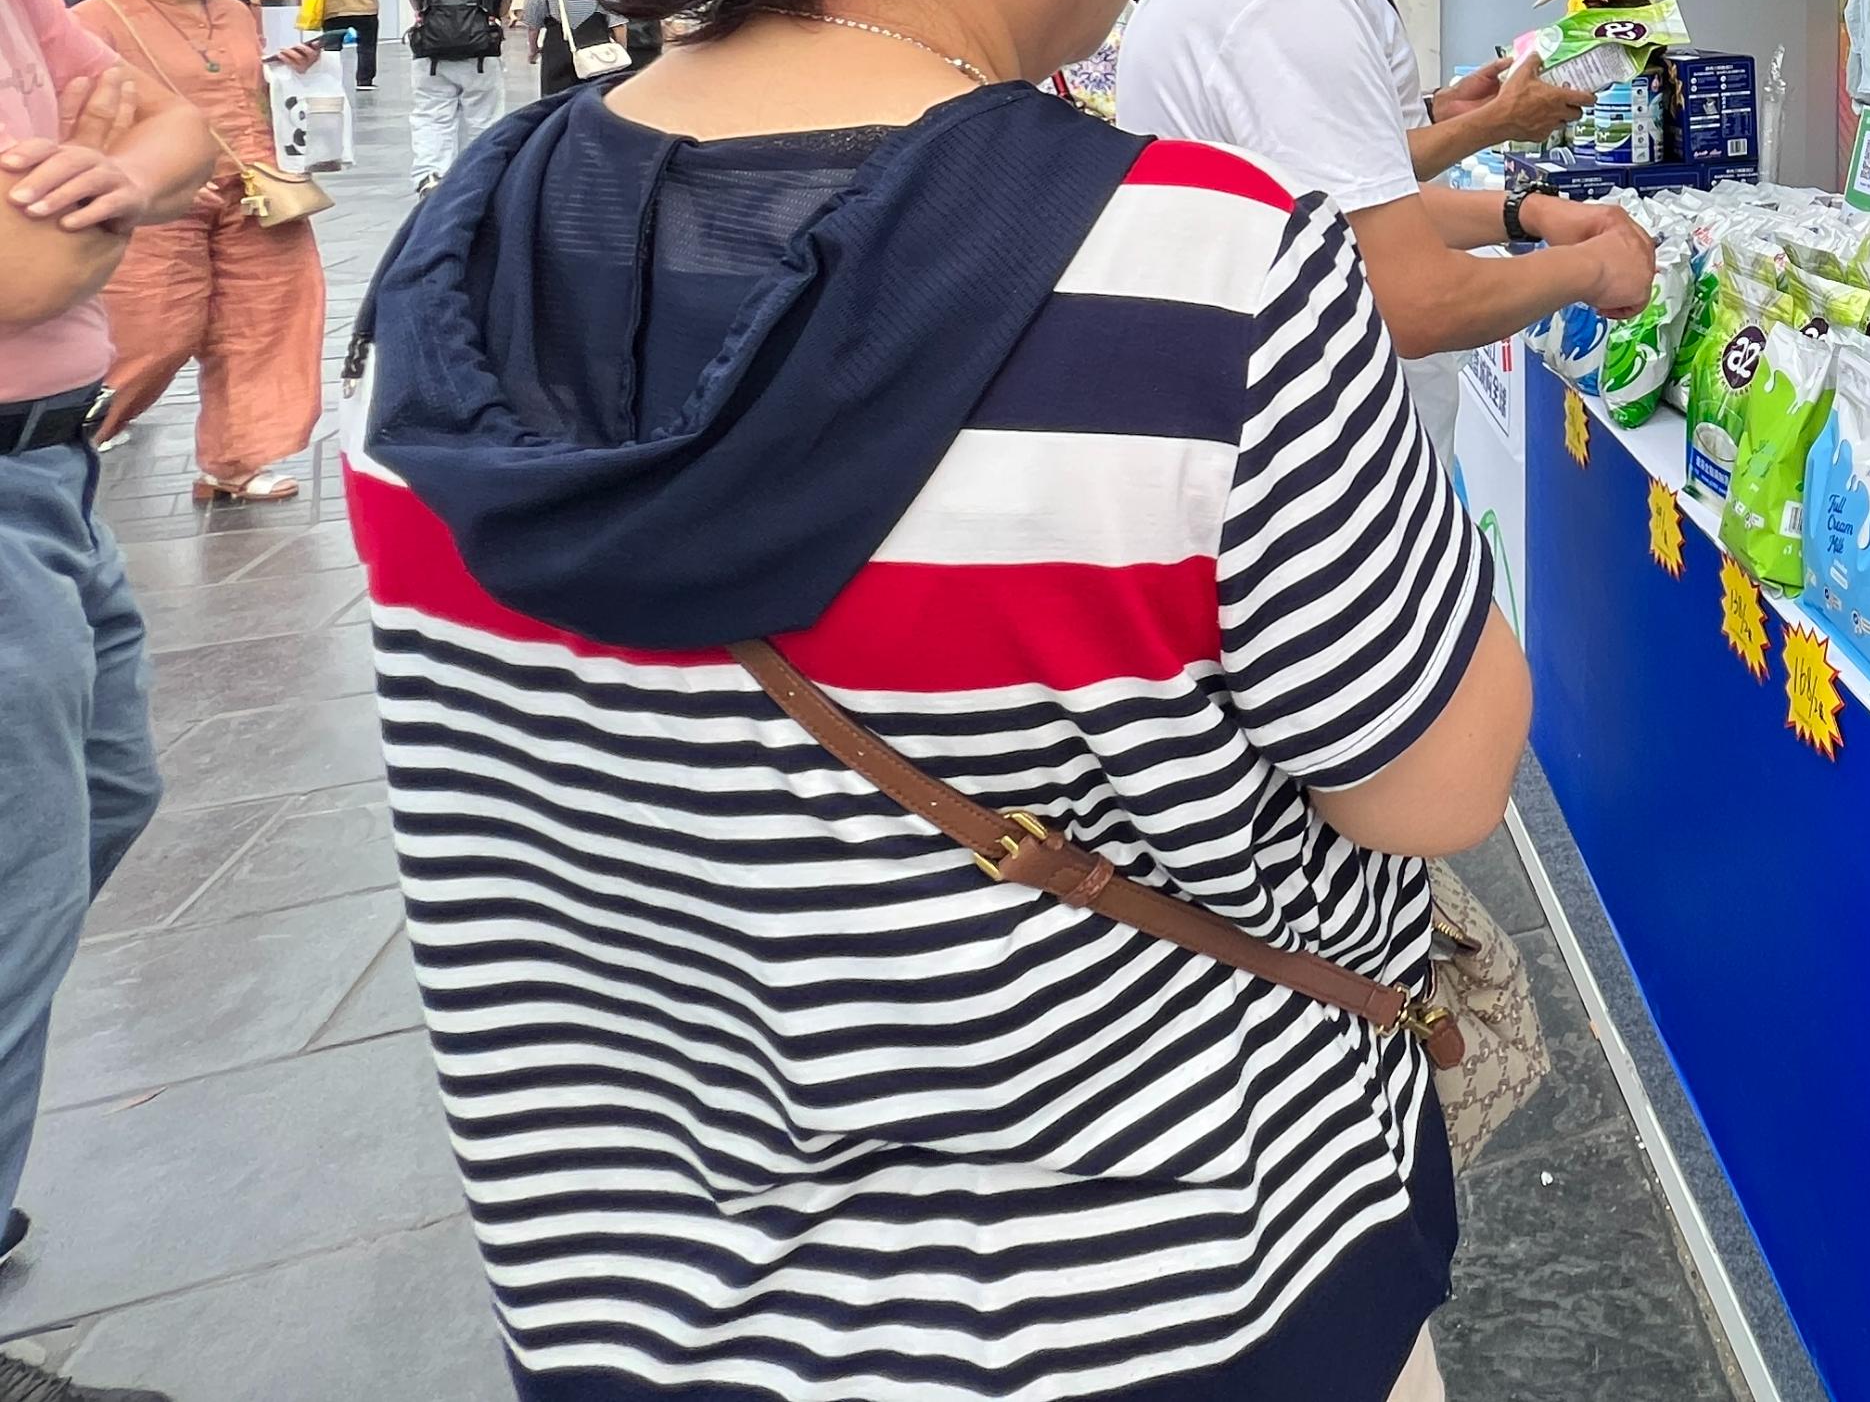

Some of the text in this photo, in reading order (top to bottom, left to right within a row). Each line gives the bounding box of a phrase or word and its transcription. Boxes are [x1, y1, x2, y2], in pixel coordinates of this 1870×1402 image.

[1829, 494, 1846, 514] Full
[1826, 514, 1854, 535] Cream
[1825, 534, 1846, 555] Milk
